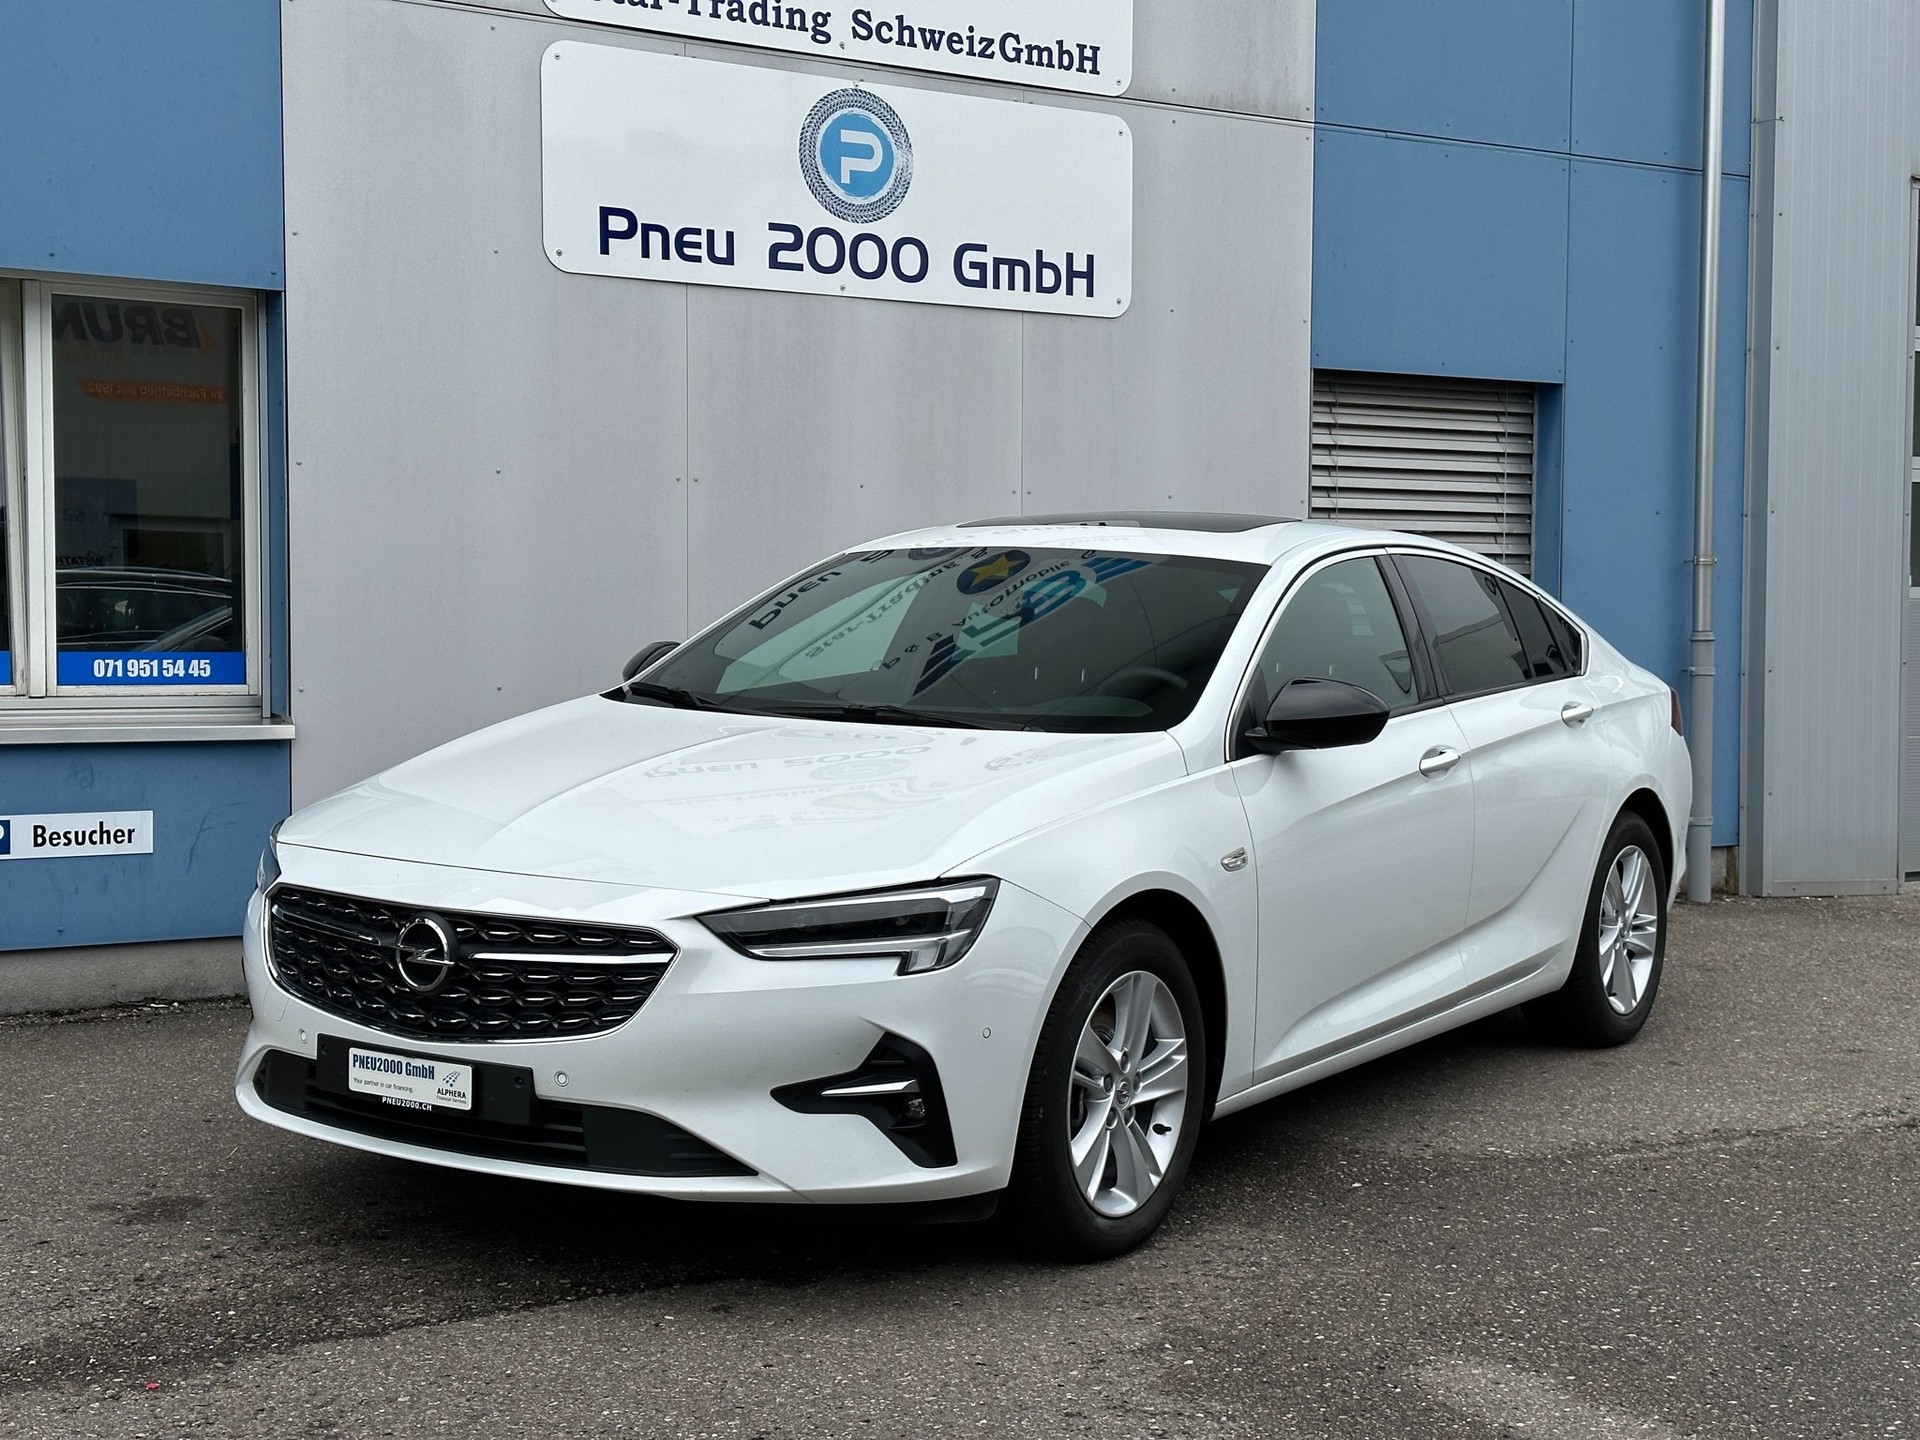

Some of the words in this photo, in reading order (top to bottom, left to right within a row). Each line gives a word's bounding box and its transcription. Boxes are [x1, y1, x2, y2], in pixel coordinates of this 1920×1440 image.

[767, 222, 930, 284] 2000
[953, 242, 1096, 299] GmbH
[93, 659, 123, 677] 071
[127, 659, 158, 677] 951
[162, 659, 185, 677] 54
[188, 659, 211, 677] 45
[32, 820, 136, 848] Besucher
[352, 1053, 403, 1075] PNEU2000
[405, 1061, 435, 1080] GmbH
[381, 1096, 432, 1111] PNEU2000.CH
[437, 1087, 467, 1099] ALPHERA
